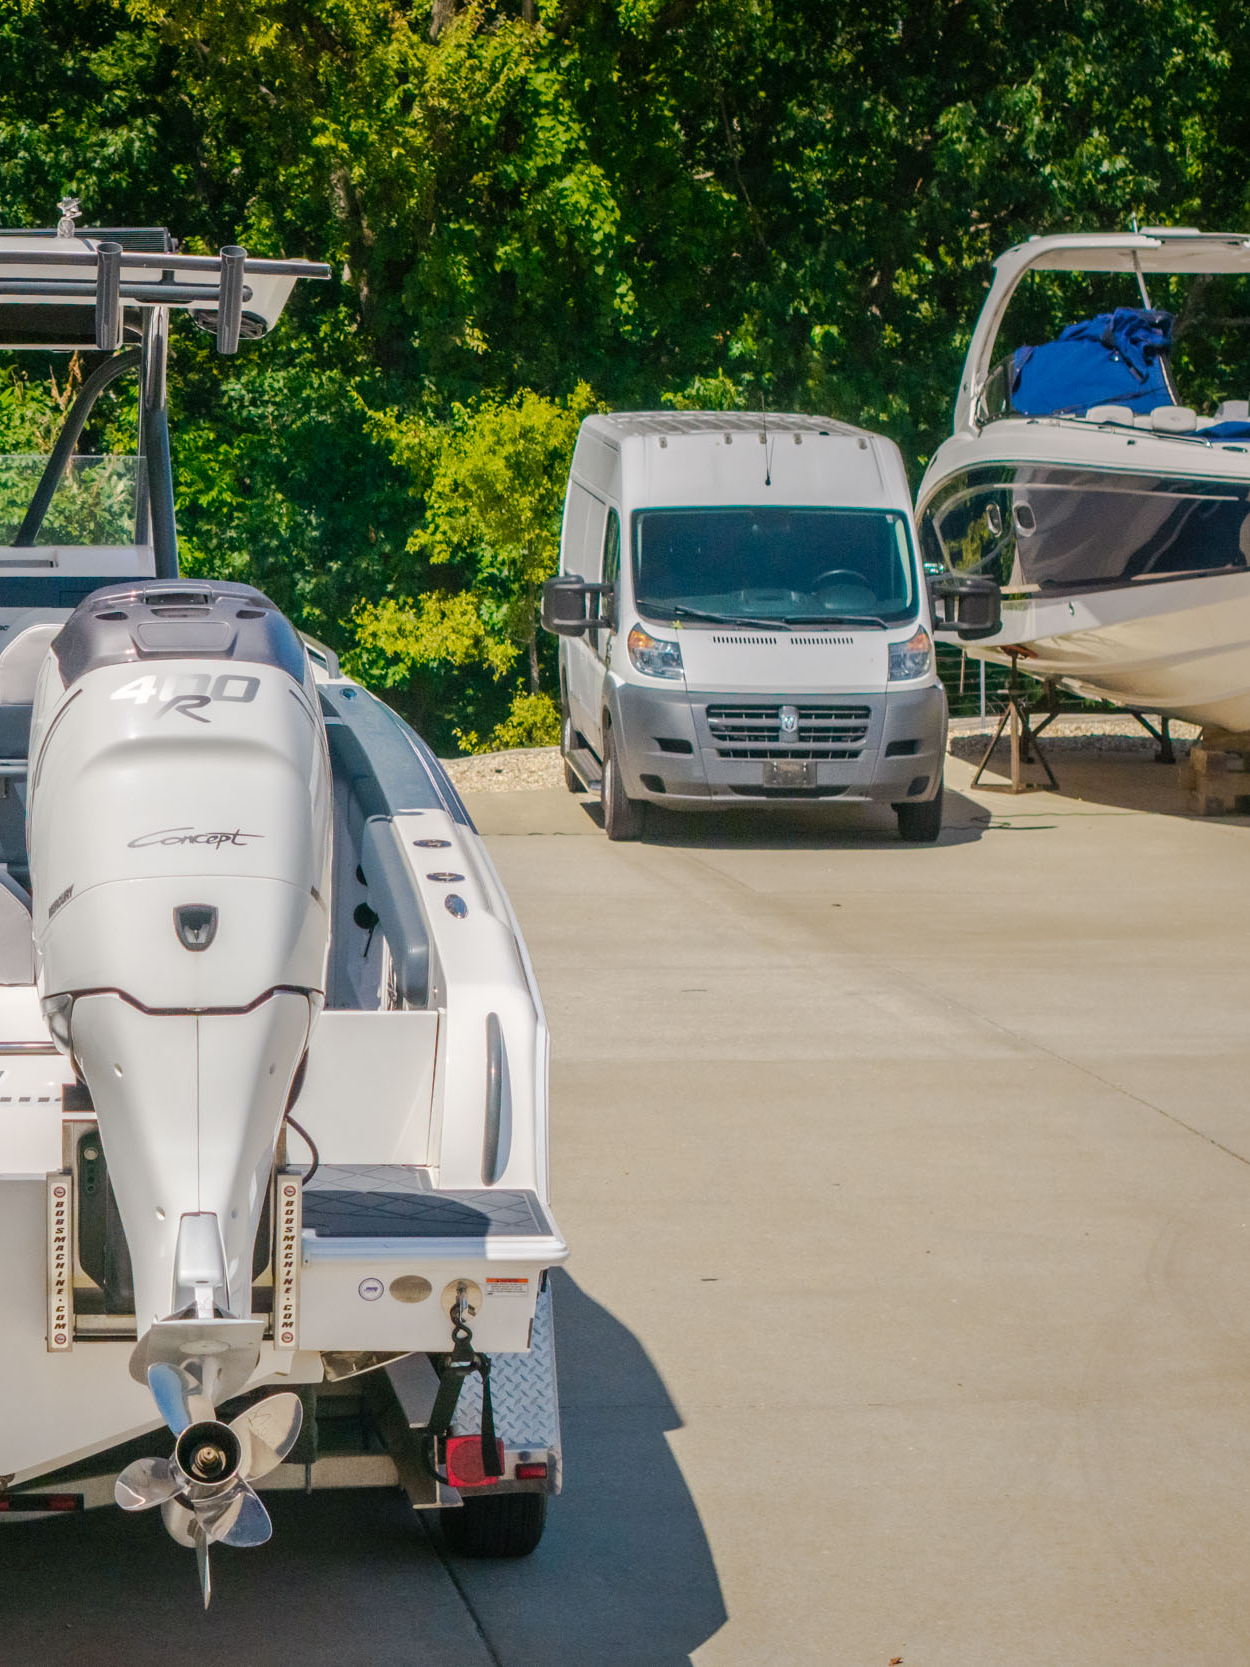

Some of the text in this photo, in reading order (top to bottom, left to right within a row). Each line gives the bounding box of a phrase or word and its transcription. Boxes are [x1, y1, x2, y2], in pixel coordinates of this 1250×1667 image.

[110, 674, 261, 704] 400
[152, 695, 212, 723] R
[127, 827, 266, 850] Concept
